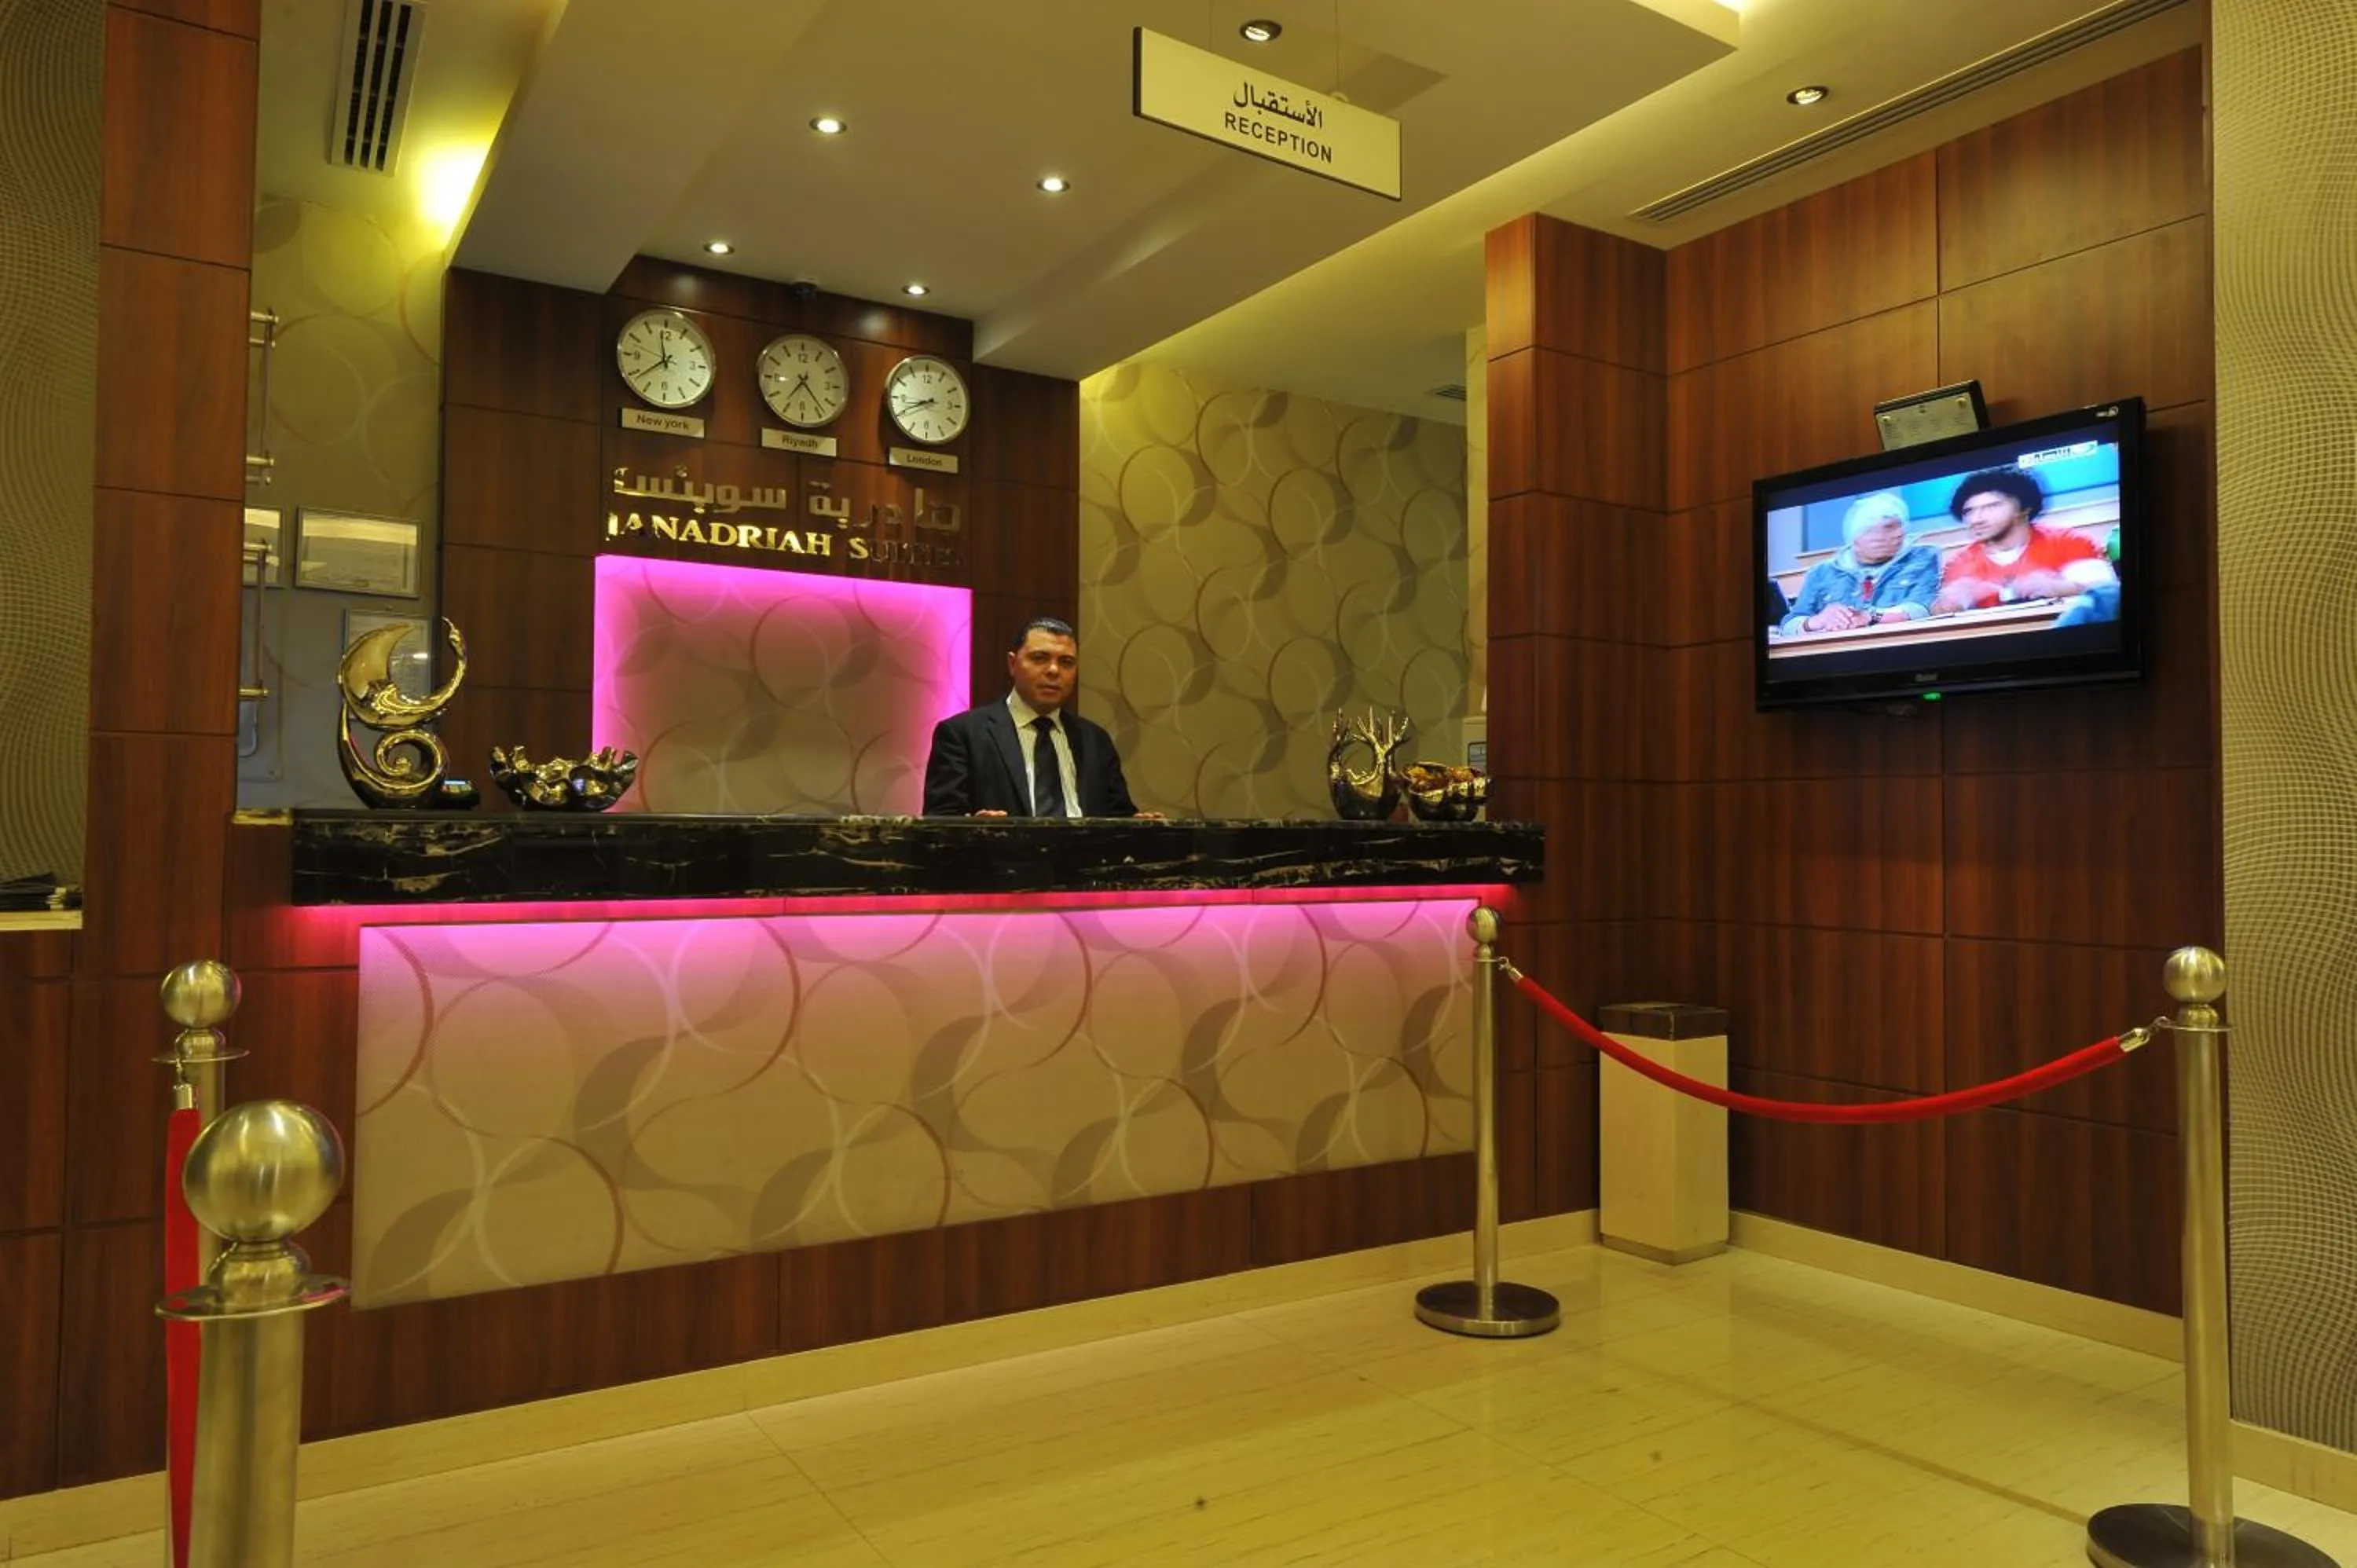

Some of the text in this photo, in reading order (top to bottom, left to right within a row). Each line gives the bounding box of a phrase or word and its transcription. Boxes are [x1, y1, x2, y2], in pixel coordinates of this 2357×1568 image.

[1233, 82, 1323, 130] الأستقبال
[1225, 112, 1332, 163] RECEPTION
[798, 354, 808, 364] 12
[922, 375, 933, 384] 12
[636, 414, 690, 430] New york
[782, 434, 819, 449] Riyadh
[906, 453, 943, 467] London
